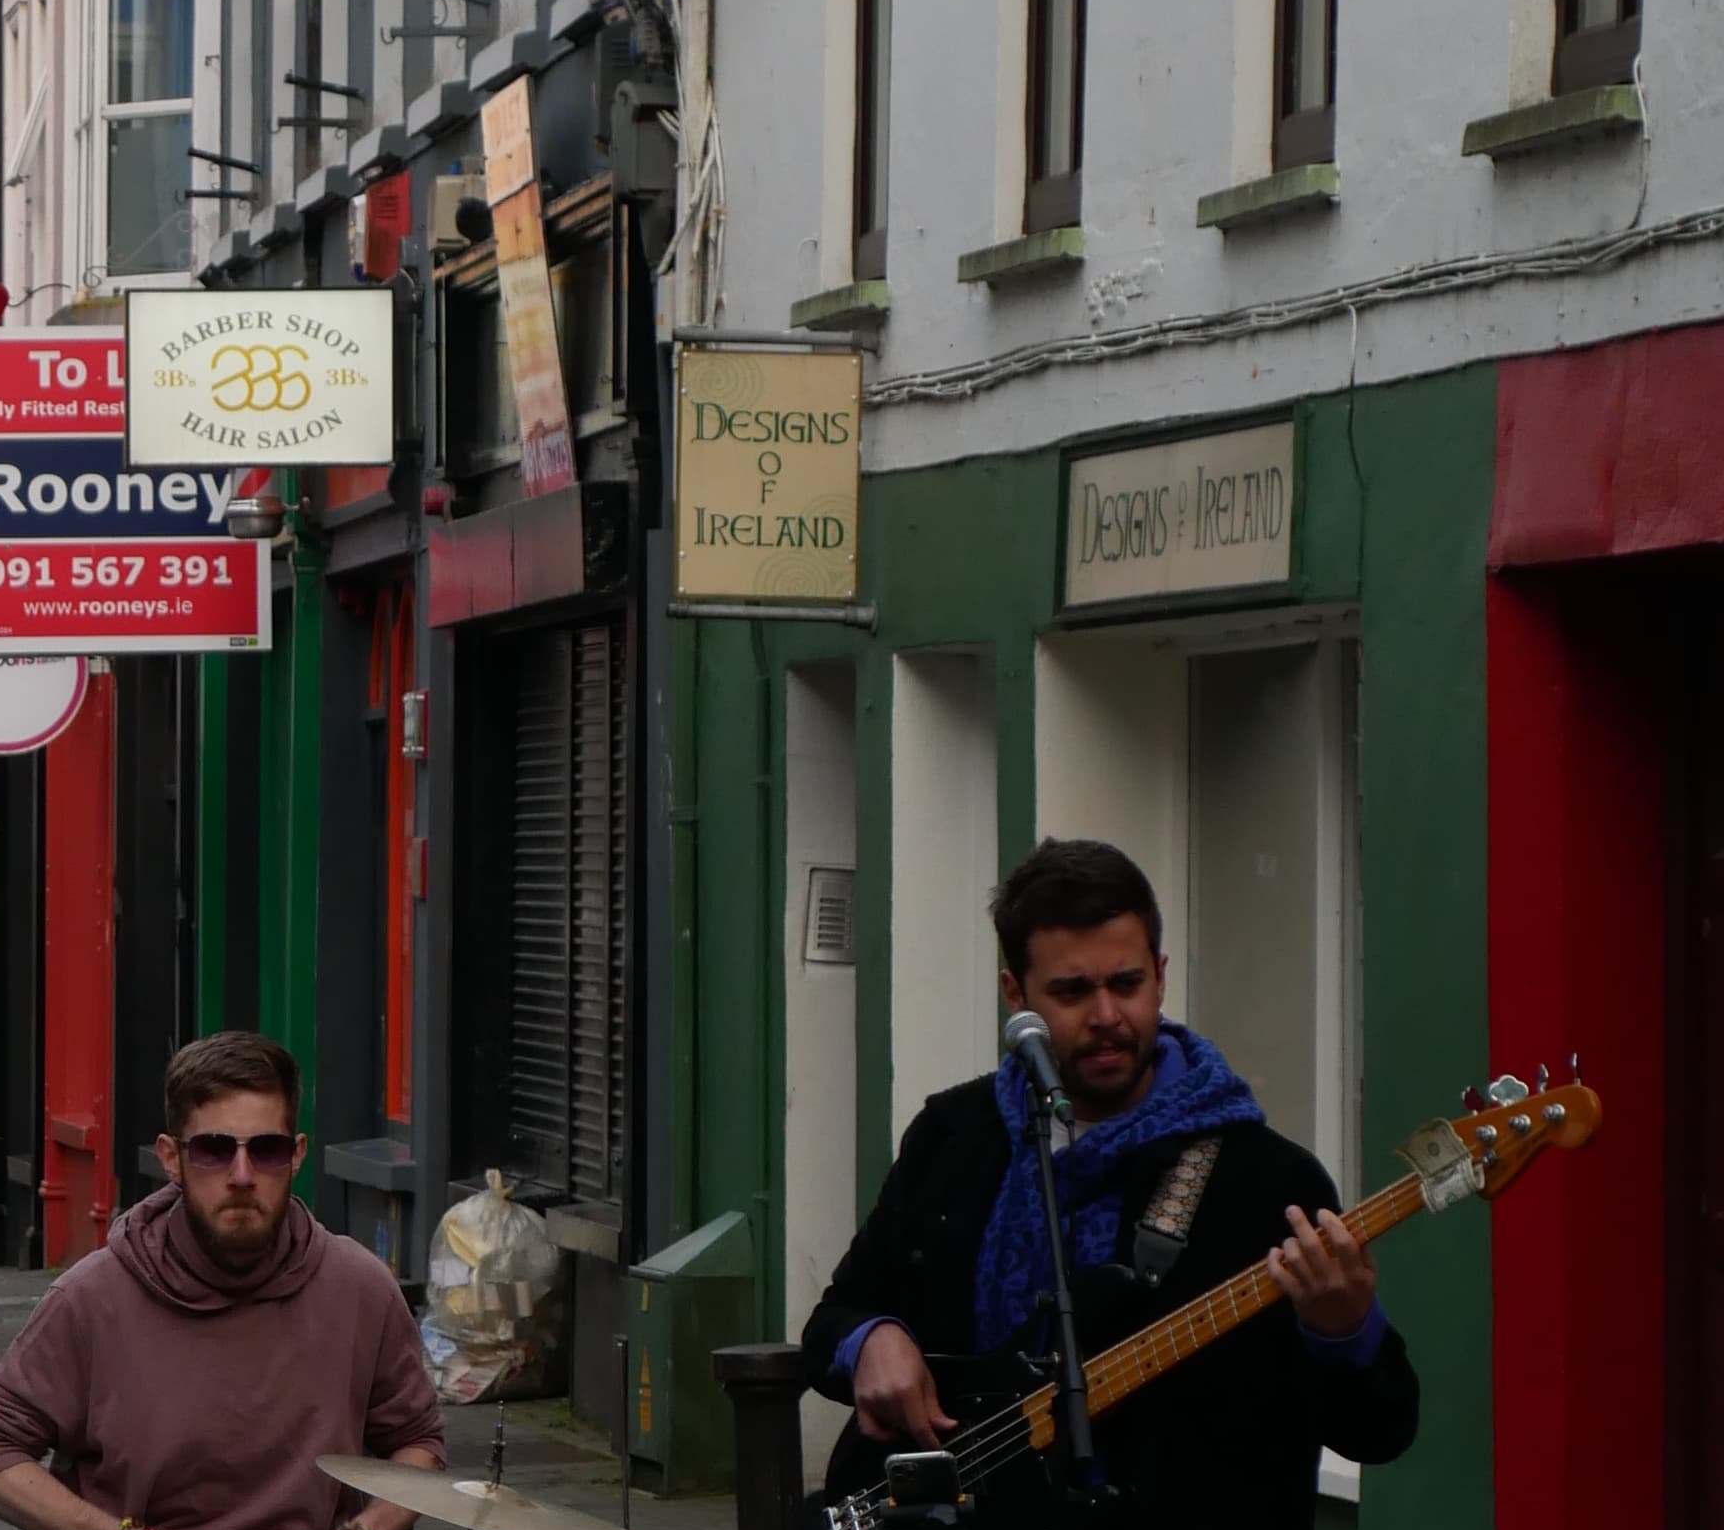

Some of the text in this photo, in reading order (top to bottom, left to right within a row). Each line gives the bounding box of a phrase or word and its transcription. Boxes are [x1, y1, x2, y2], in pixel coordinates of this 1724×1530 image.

[160, 310, 361, 362] BARBER SHOP
[28, 349, 87, 389] To
[153, 369, 196, 388] 3B's
[325, 368, 369, 387] 3B's
[21, 400, 78, 417] Fitted
[84, 400, 124, 416] Rest
[180, 407, 343, 450] HAIR SALON
[71, 556, 145, 587] 567
[159, 555, 233, 586] 391
[23, 596, 193, 618] www.rooneys.ie
